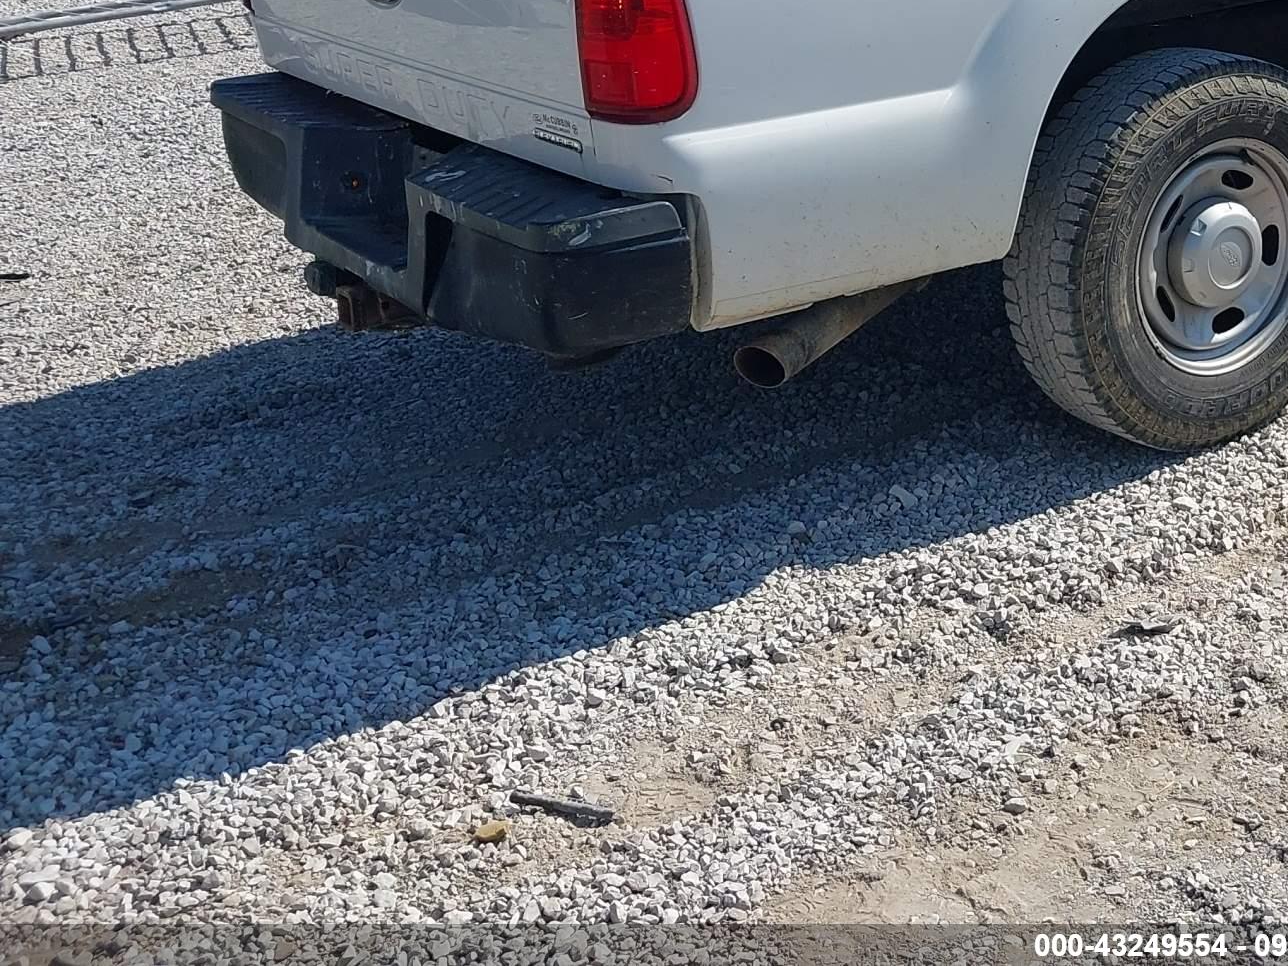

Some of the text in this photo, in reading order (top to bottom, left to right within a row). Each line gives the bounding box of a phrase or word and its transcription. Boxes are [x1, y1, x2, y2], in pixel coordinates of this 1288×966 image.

[302, 40, 511, 140] SUPER DUTY
[1197, 98, 1284, 137] FURY
